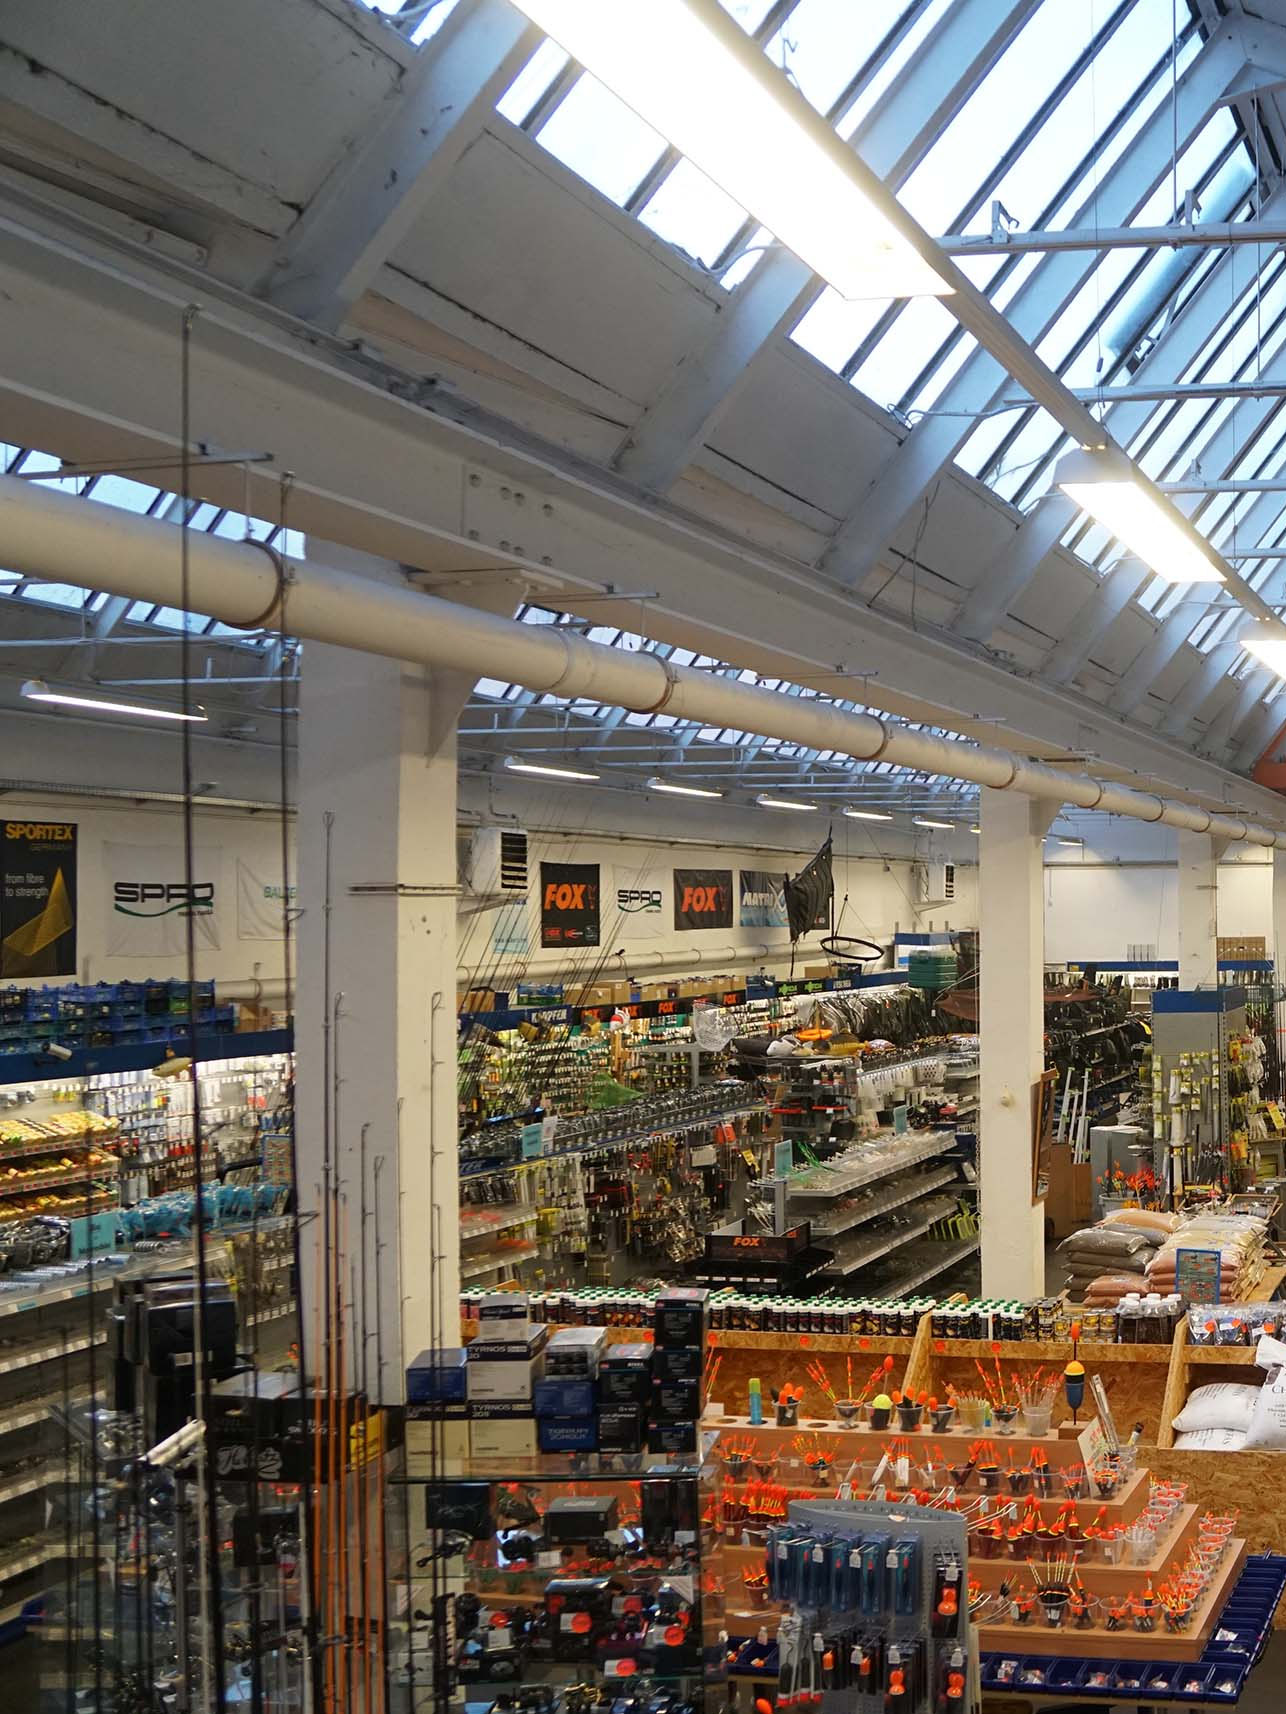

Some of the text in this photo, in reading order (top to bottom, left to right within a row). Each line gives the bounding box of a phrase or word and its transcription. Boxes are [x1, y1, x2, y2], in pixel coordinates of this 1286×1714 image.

[5, 823, 73, 840] SPORTEX
[544, 883, 586, 911] FOX
[617, 890, 662, 904] SPRO
[681, 886, 718, 912] FOX
[658, 1002, 674, 1014] FOX
[734, 1237, 760, 1246] FOX
